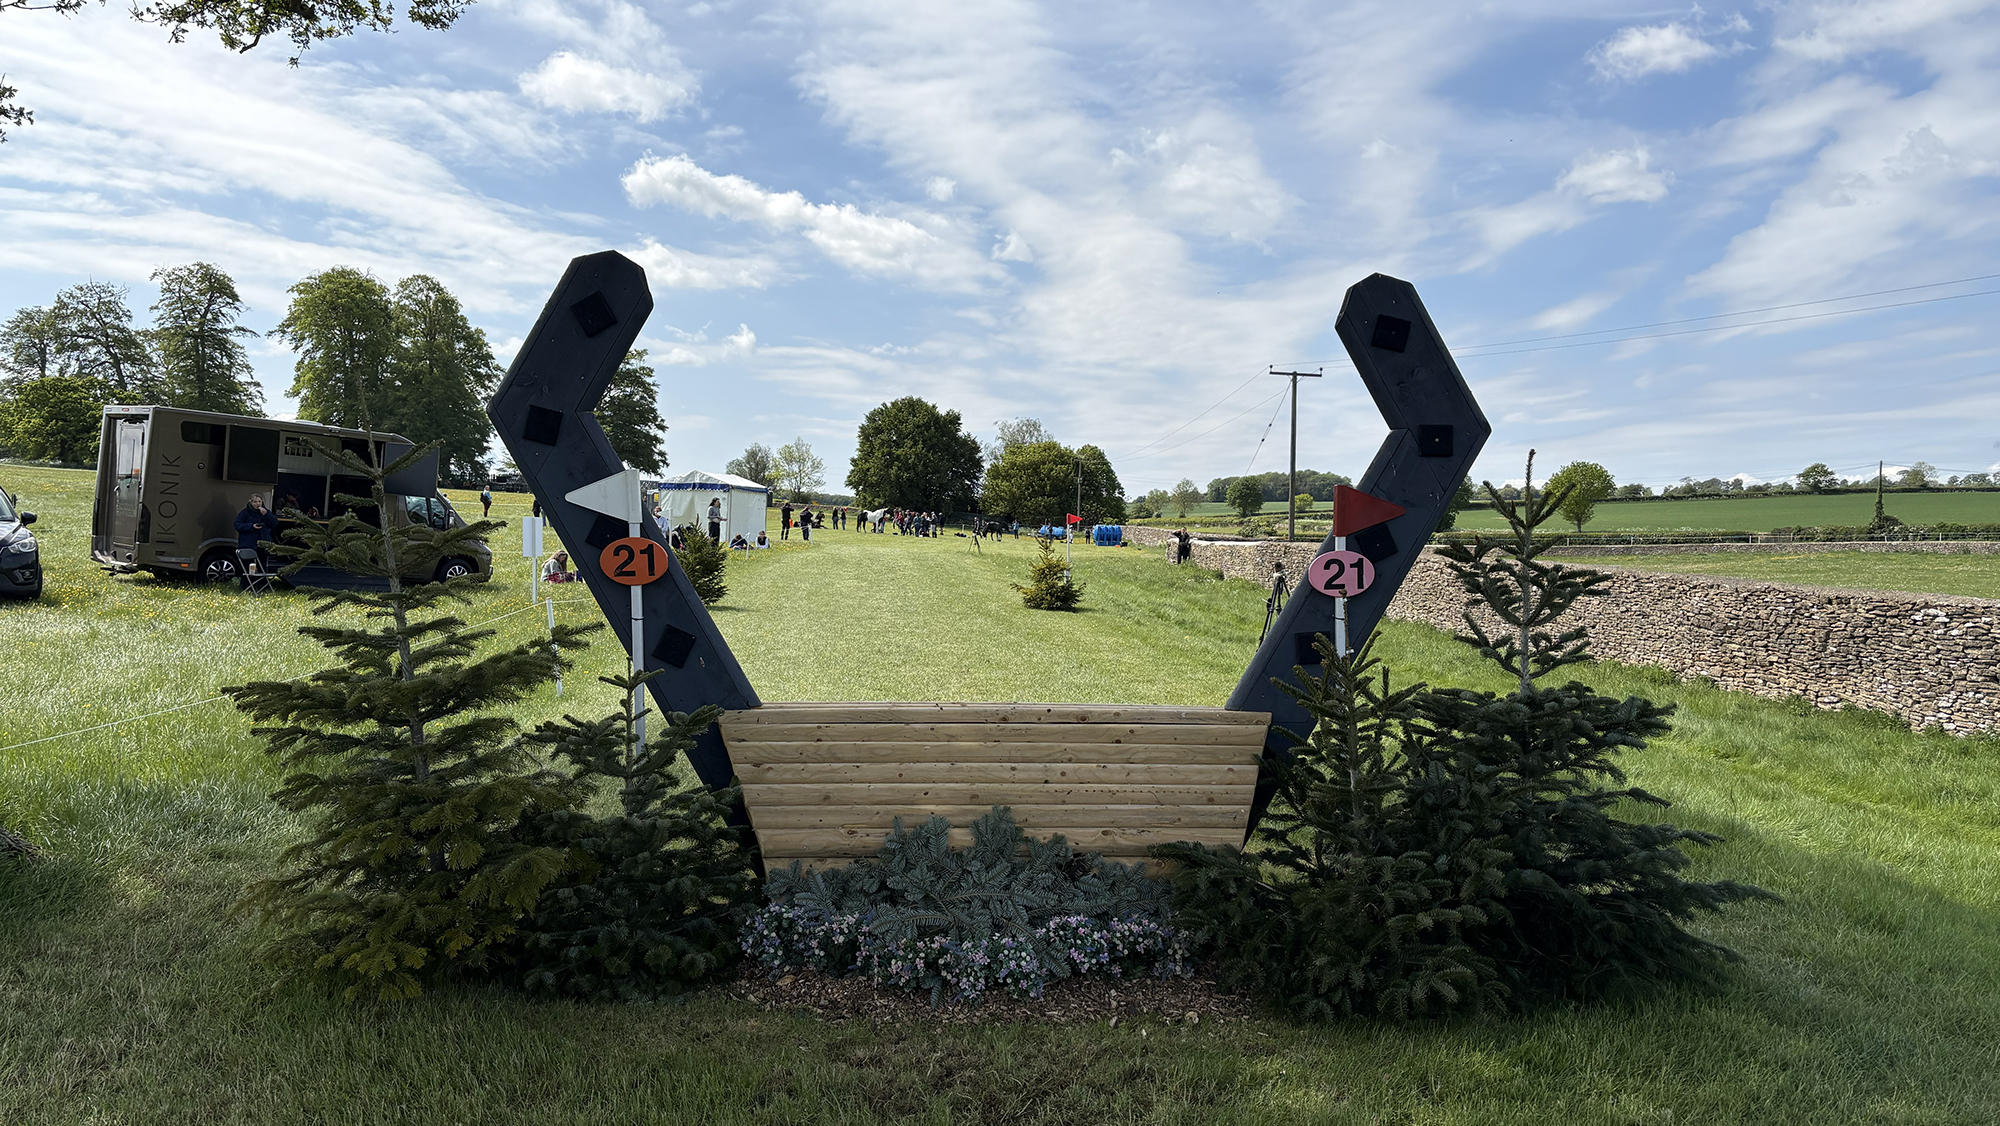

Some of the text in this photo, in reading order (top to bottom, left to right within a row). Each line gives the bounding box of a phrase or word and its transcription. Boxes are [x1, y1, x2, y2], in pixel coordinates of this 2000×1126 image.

[156, 454, 182, 544] IKONIK
[613, 544, 656, 577] 21
[1323, 557, 1364, 590] 21
